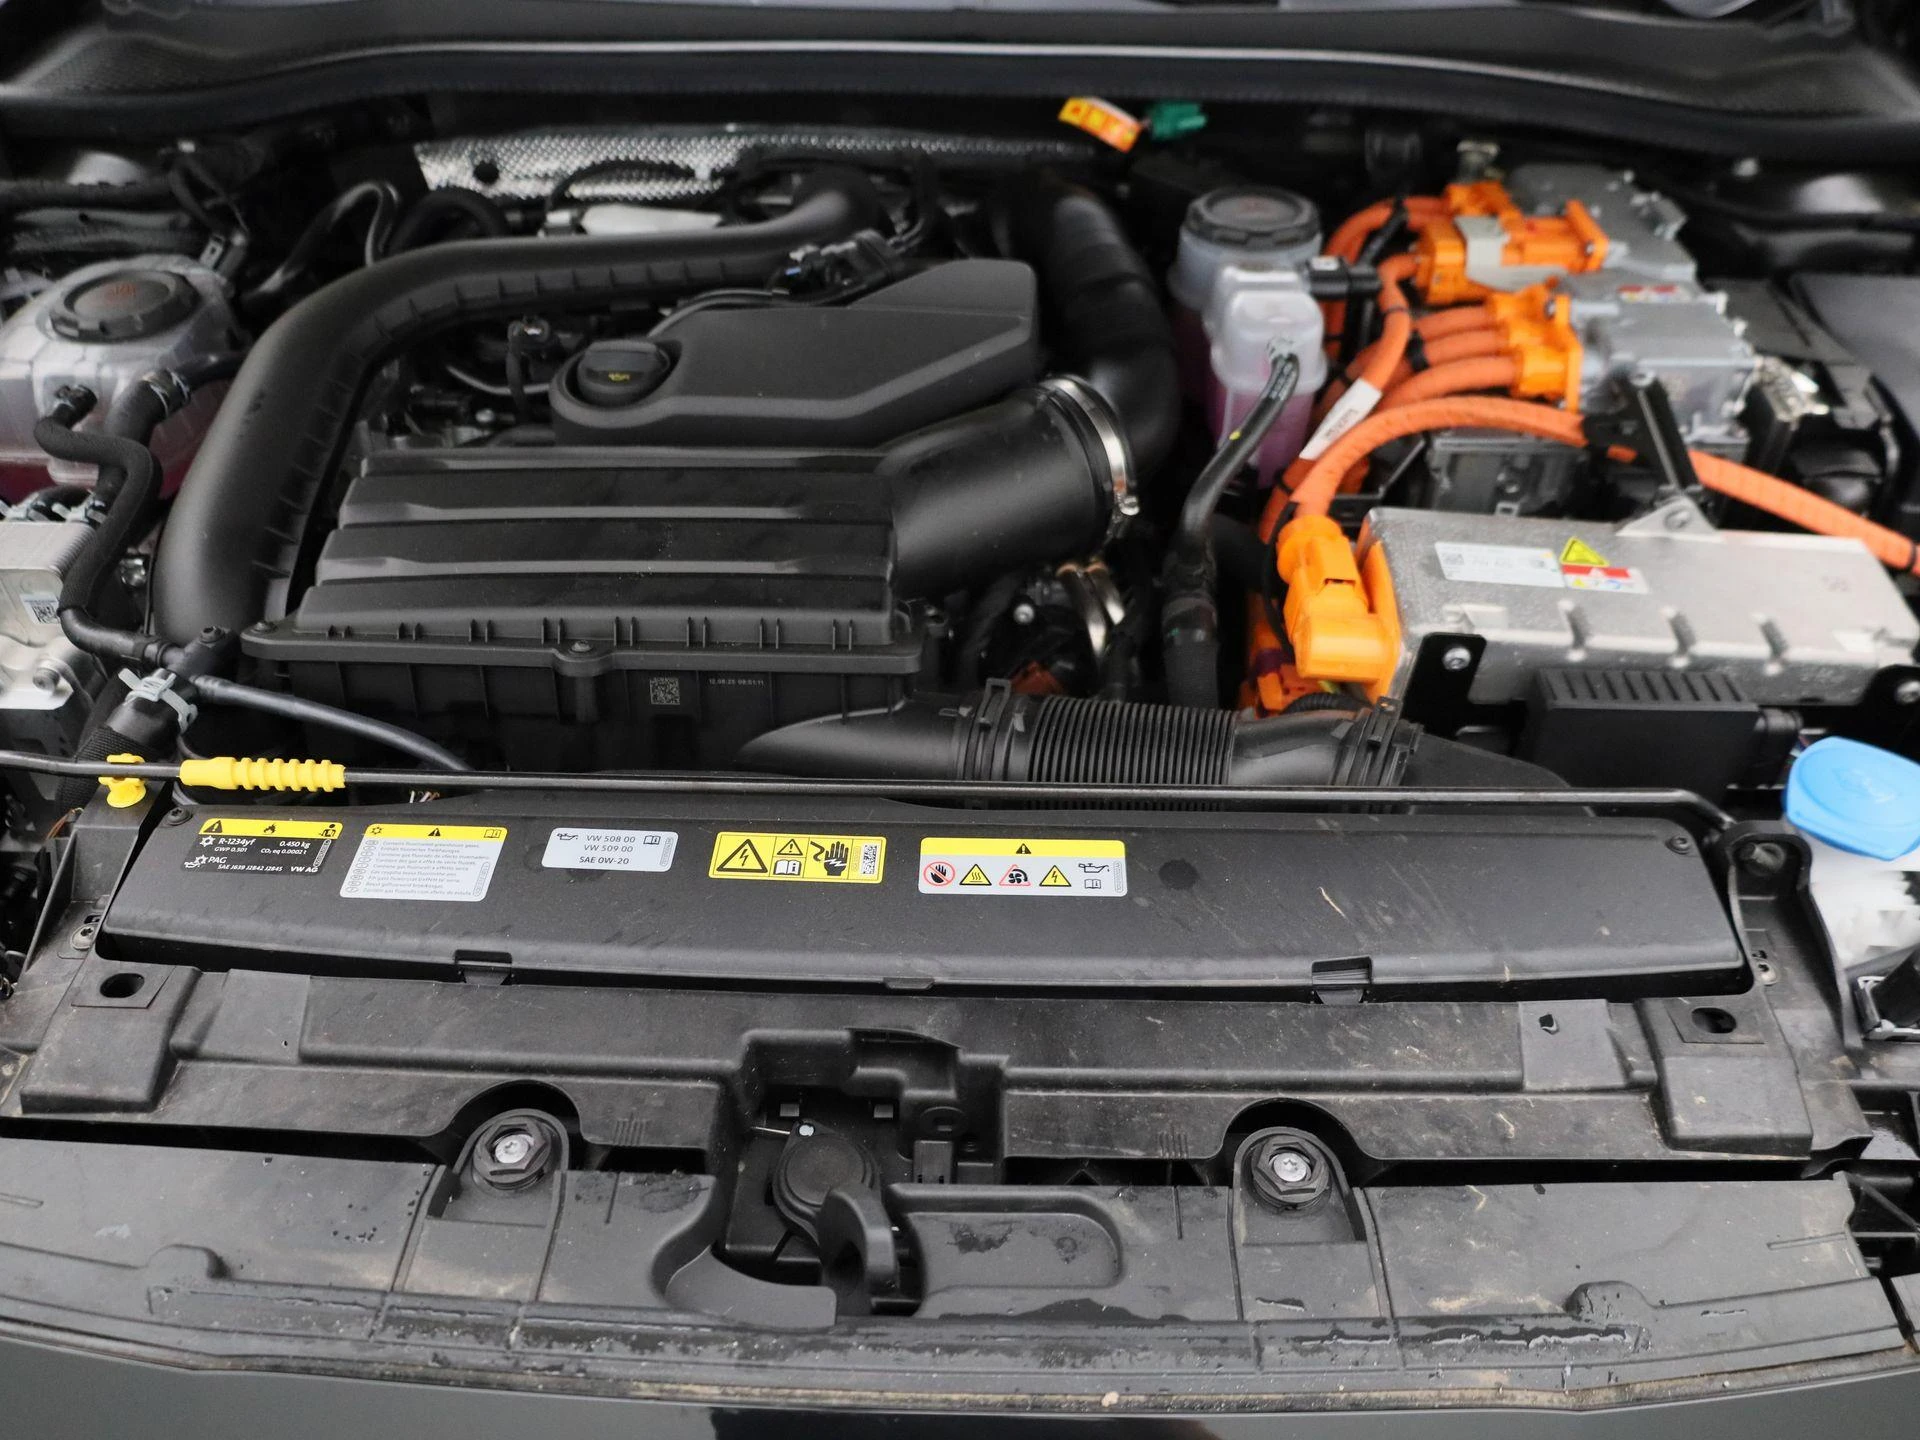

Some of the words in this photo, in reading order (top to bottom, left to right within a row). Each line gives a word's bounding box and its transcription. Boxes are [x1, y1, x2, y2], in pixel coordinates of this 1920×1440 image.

[218, 838, 257, 847] R-1234yf
[604, 835, 622, 843] 508
[301, 841, 311, 849] kg
[208, 856, 227, 864] PAG
[579, 856, 596, 864] SAE
[597, 857, 629, 865] 0W-20
